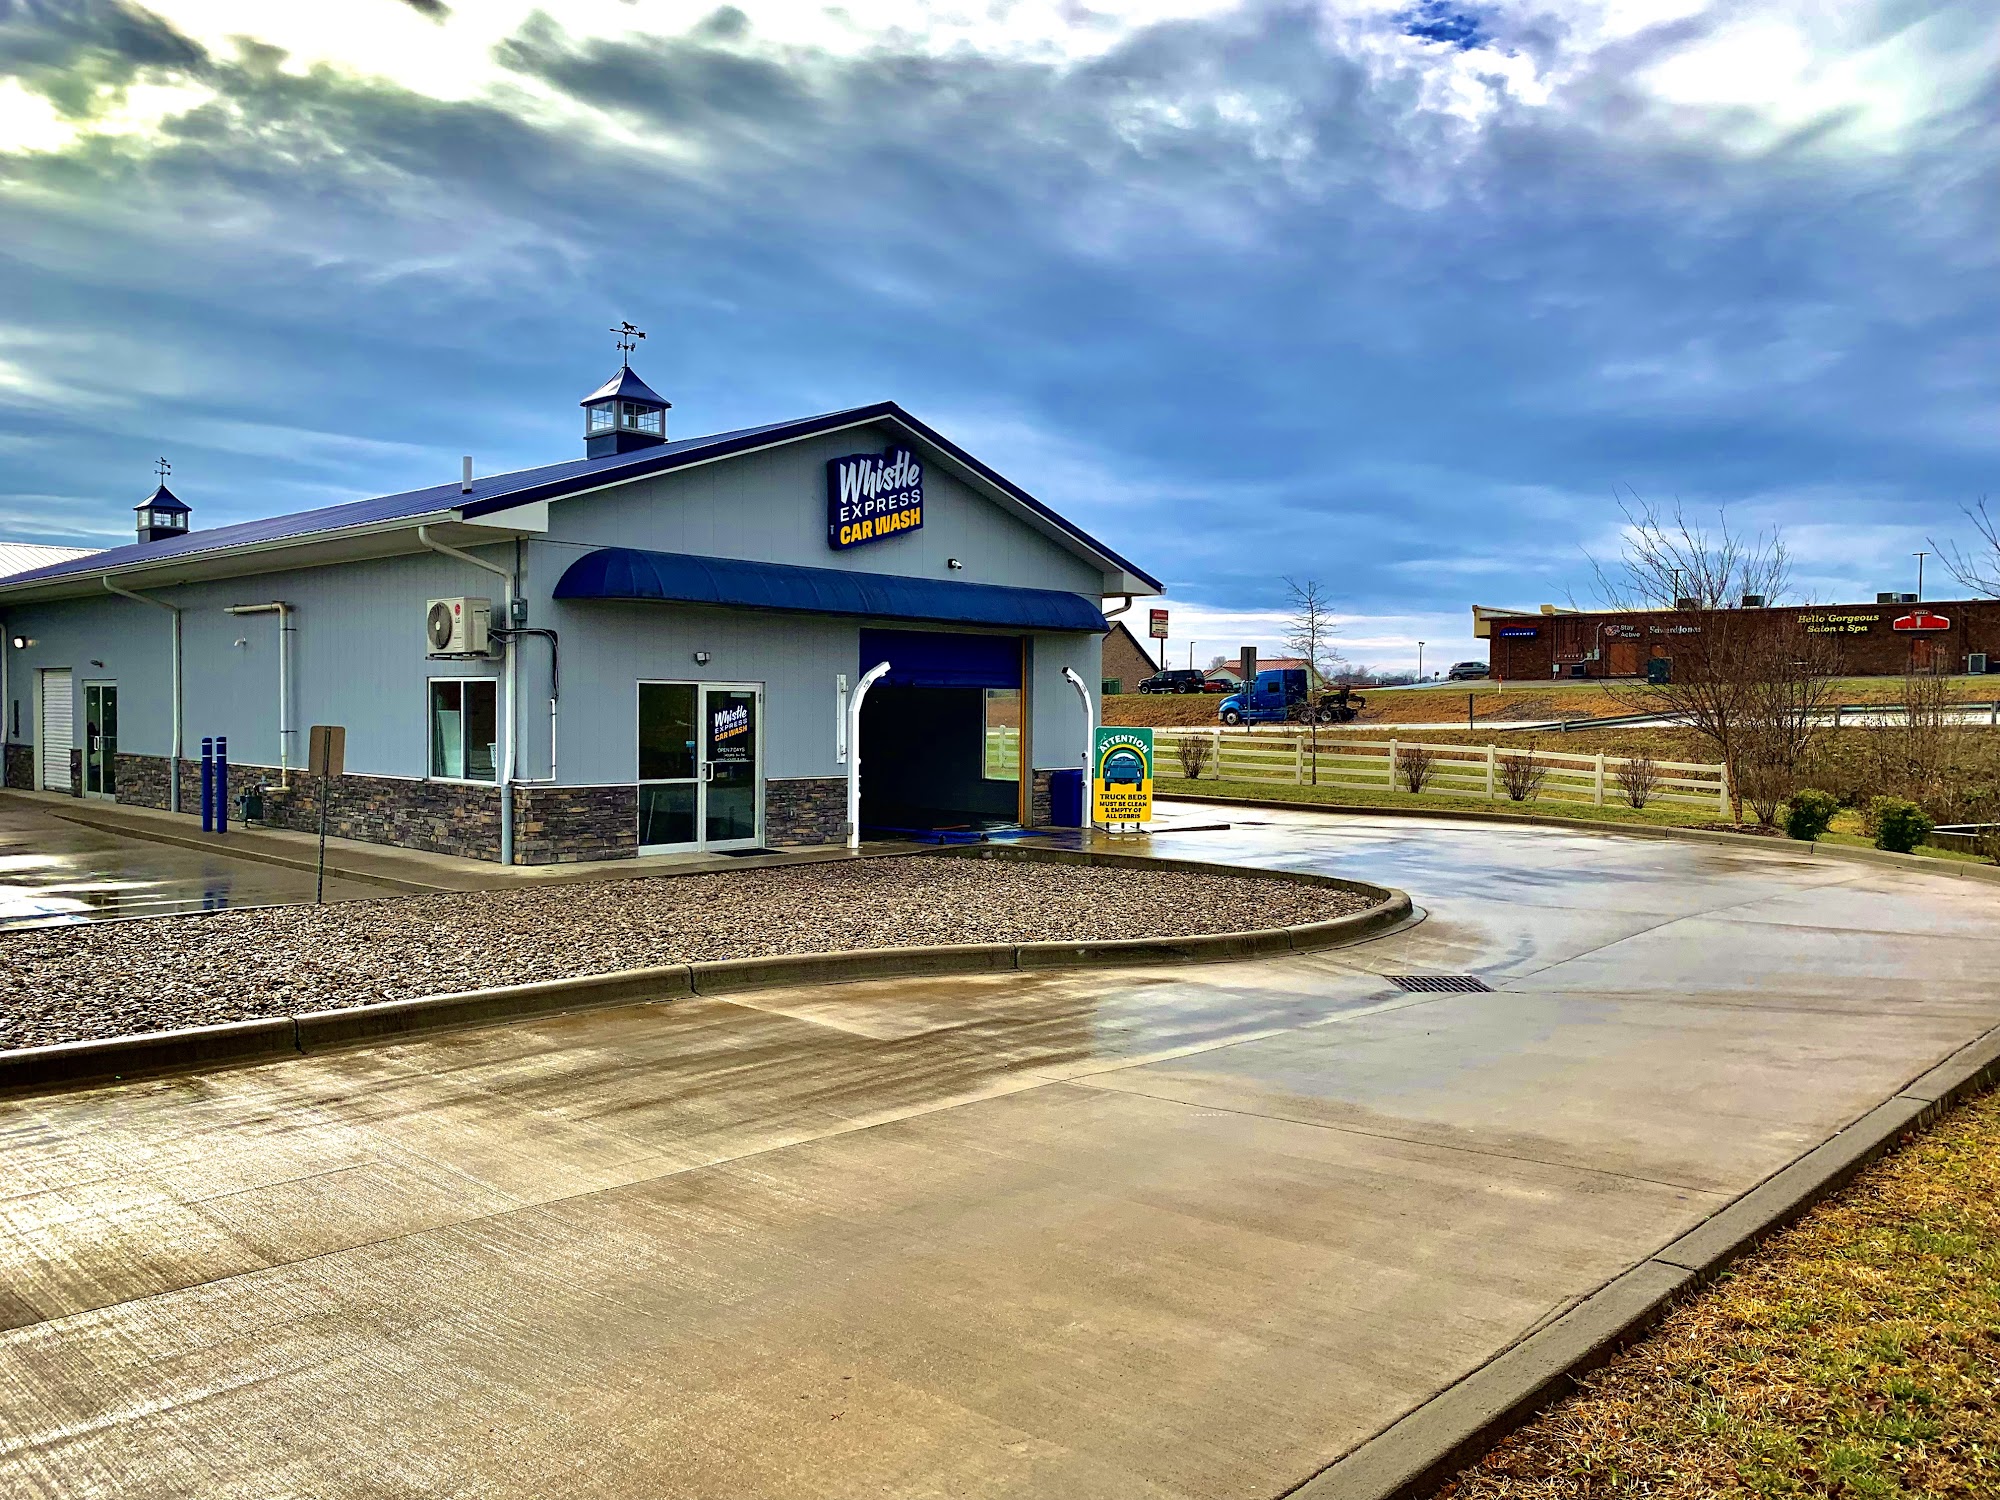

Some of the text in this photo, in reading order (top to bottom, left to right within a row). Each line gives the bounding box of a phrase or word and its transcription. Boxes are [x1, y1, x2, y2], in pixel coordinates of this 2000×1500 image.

[840, 450, 920, 504] Whistle
[840, 489, 920, 522] EXPRESS
[840, 521, 873, 545] CAR
[875, 507, 921, 536] WASH
[1797, 614, 1880, 624] Hello Gorgeous
[1807, 625, 1837, 633] Salon
[1847, 625, 1868, 633] Spa
[714, 705, 748, 727] Whistle
[714, 718, 748, 734] EXPRESS
[714, 725, 748, 742] CAR WASH
[1099, 735, 1150, 753] ATTENTION
